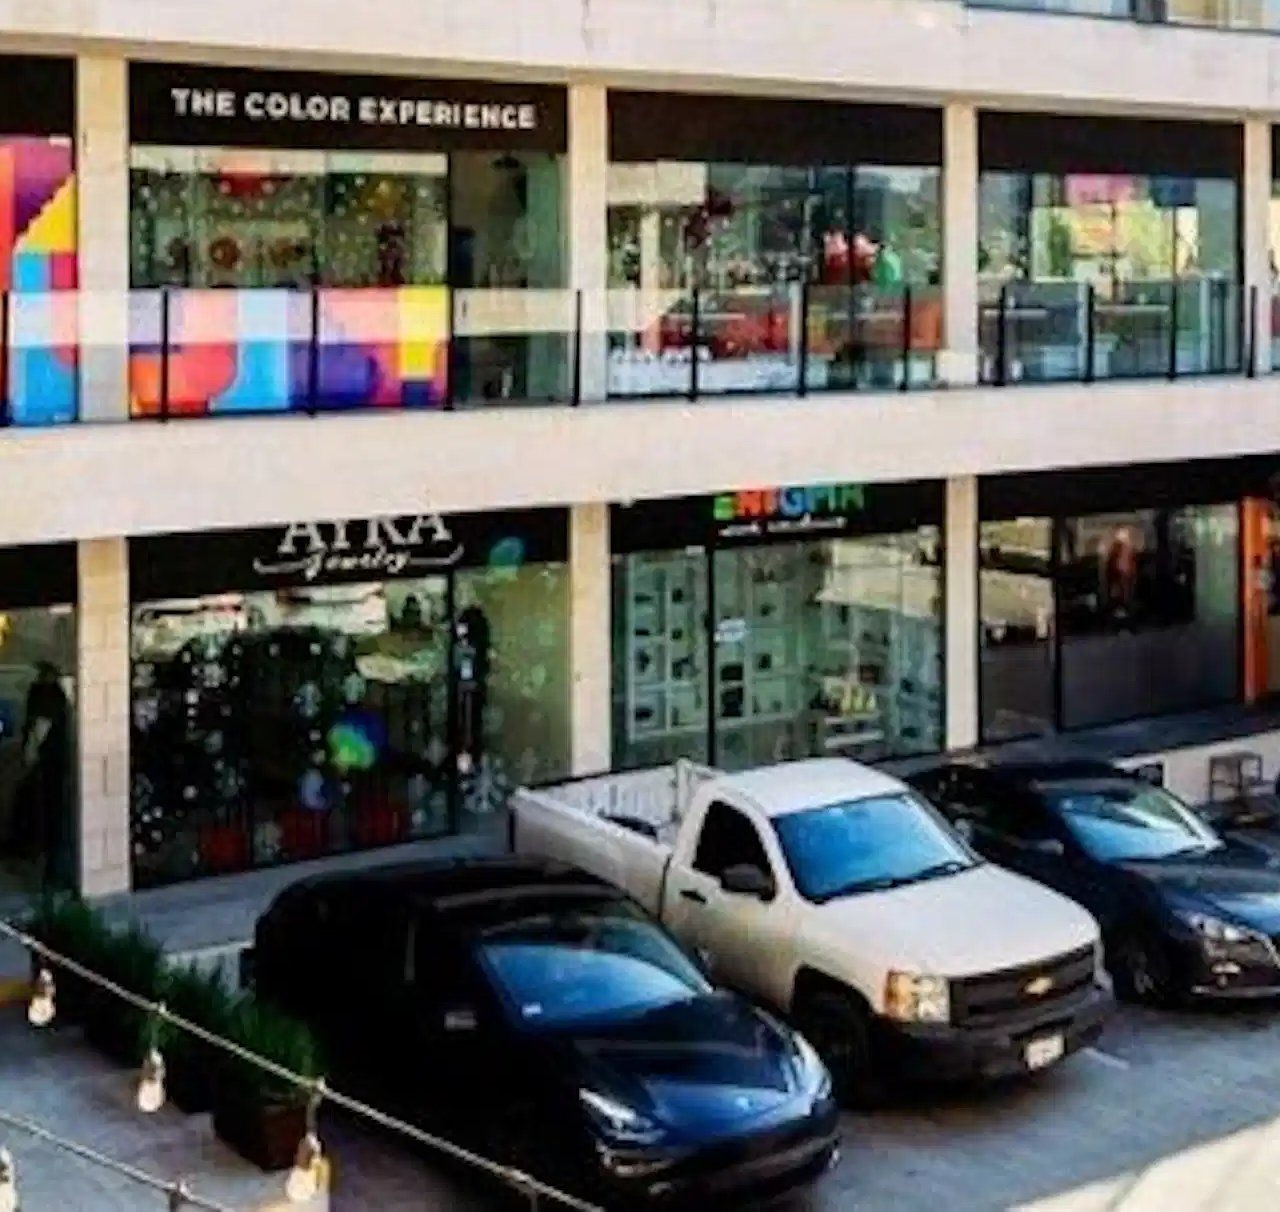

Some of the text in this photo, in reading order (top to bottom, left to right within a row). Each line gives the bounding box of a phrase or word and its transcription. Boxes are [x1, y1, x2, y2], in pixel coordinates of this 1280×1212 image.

[170, 88, 538, 129] THE COLOR EXPERIENCE
